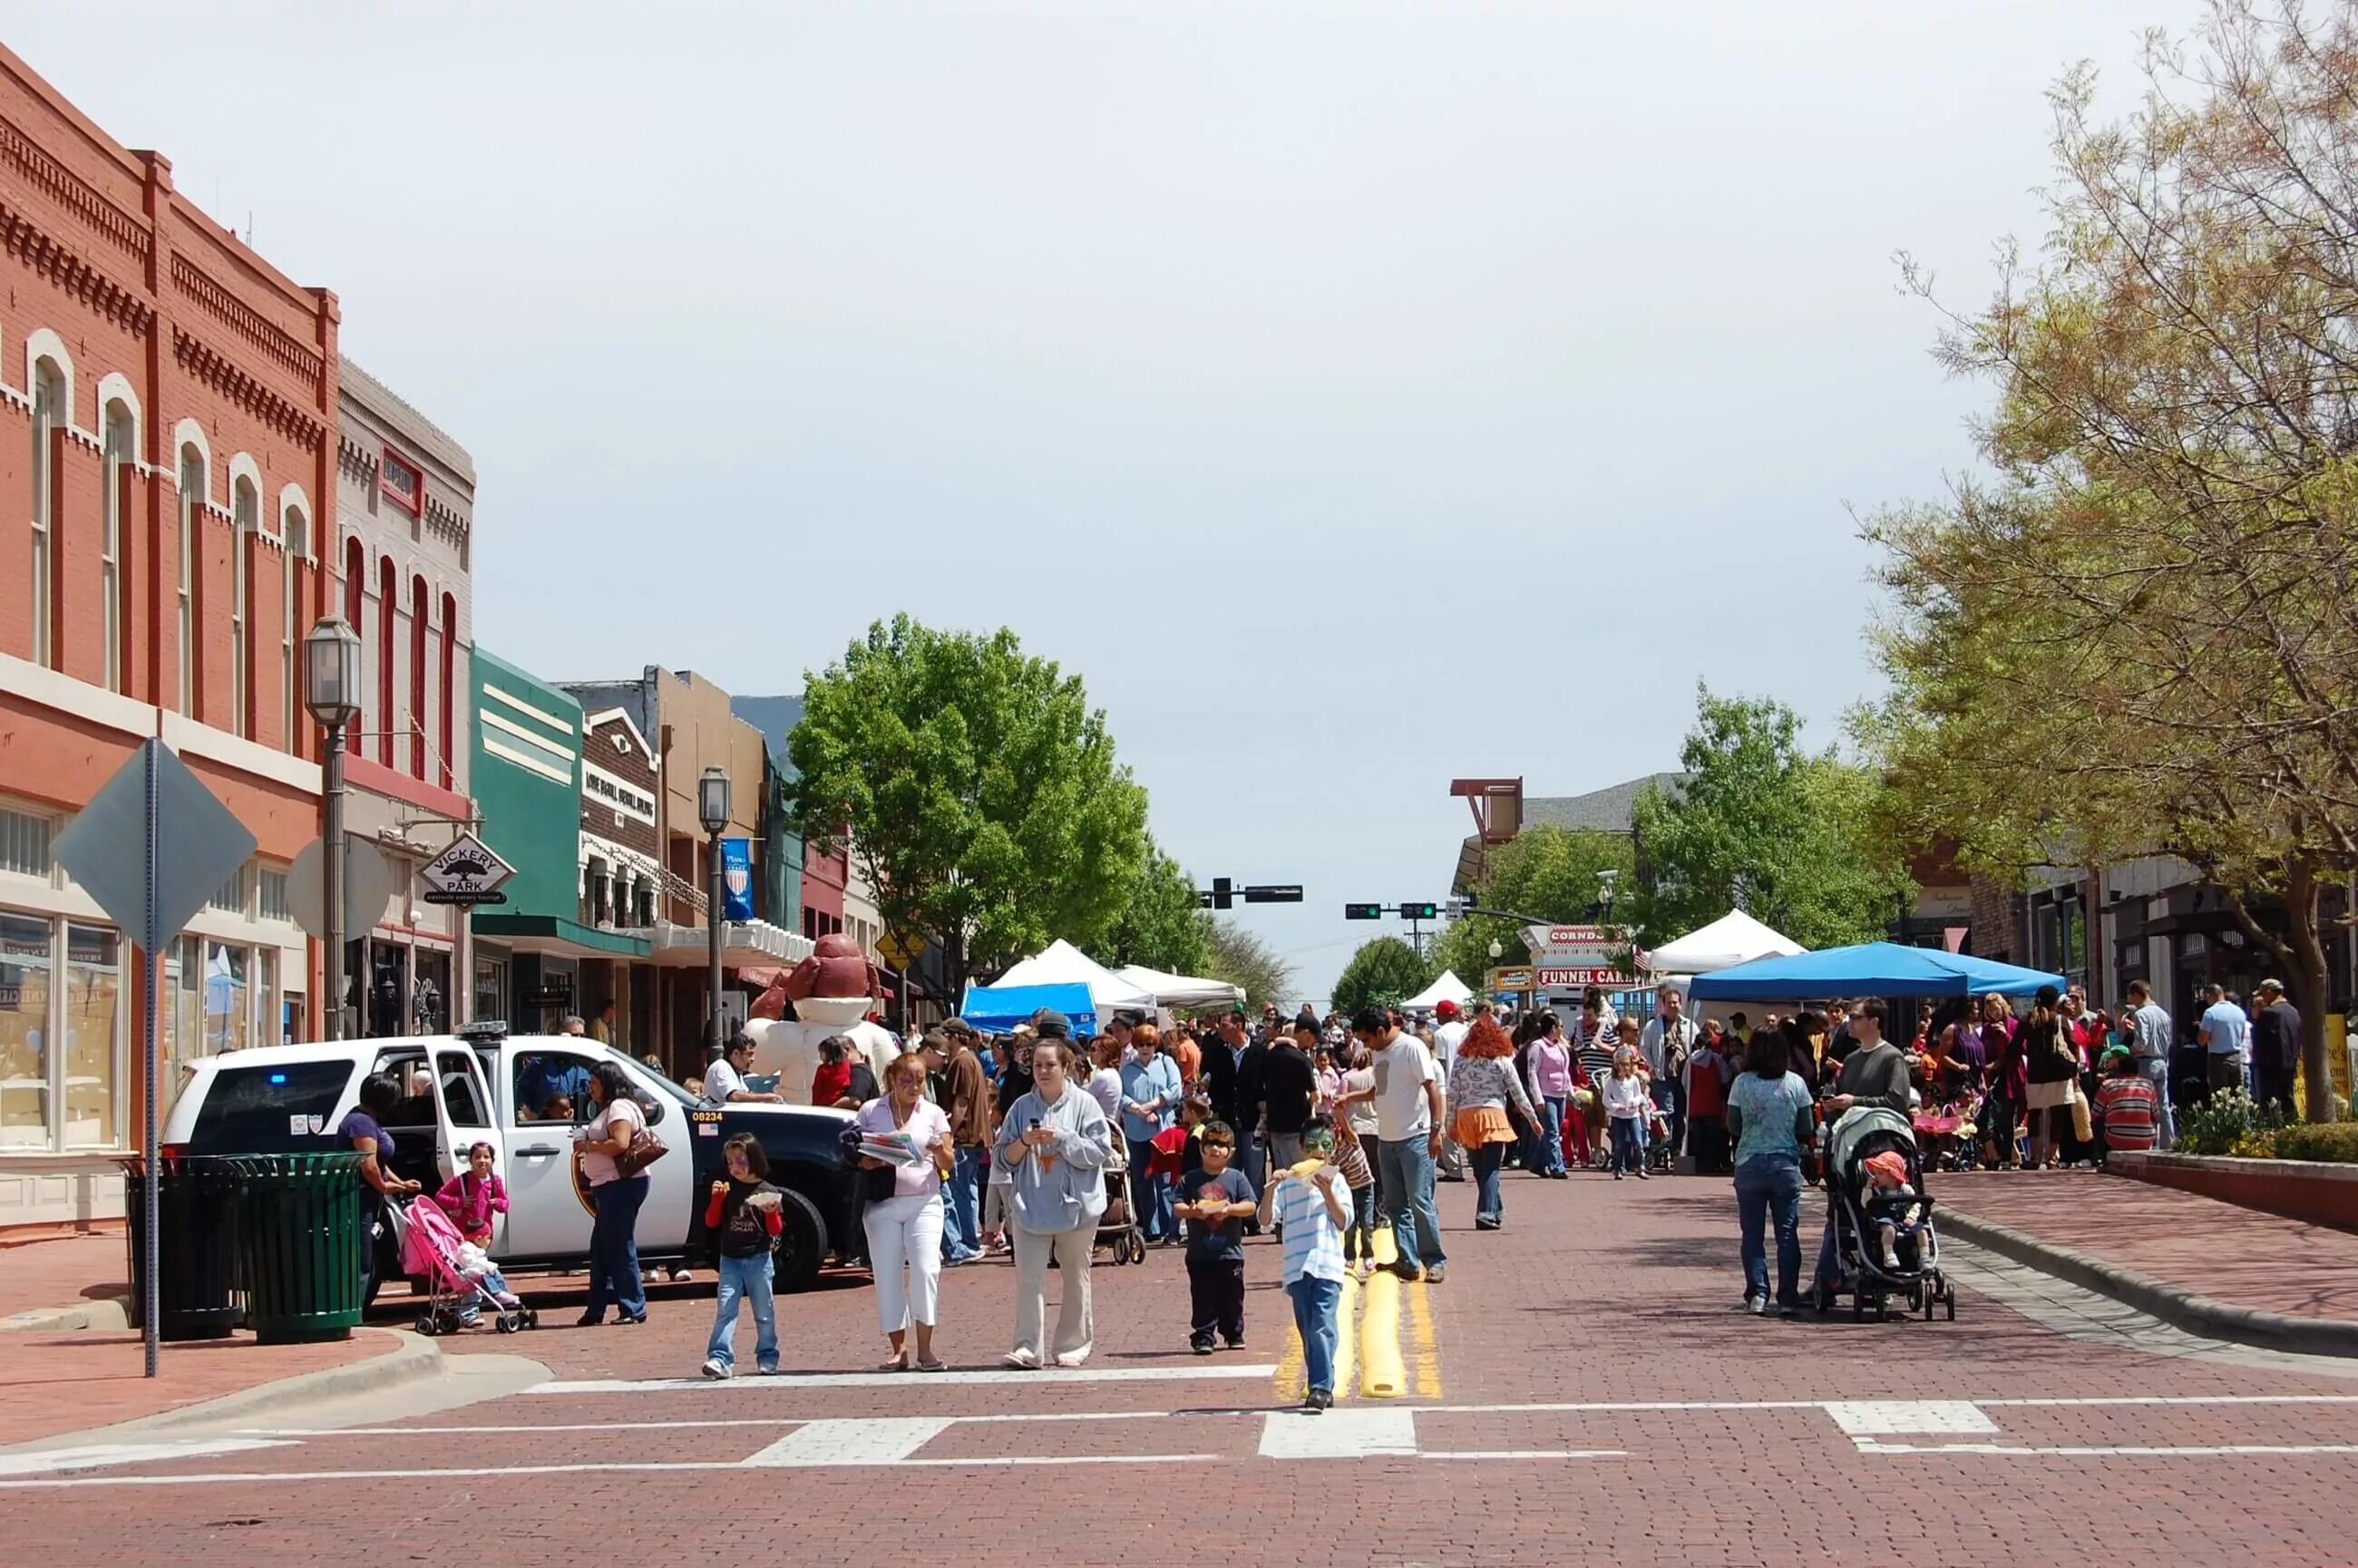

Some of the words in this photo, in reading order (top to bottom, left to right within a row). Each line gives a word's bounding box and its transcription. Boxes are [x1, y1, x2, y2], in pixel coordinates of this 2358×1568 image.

[434, 850, 496, 869] VICKERY
[447, 882, 482, 891] PARK
[1542, 970, 1594, 983] FUNNEL
[692, 1112, 723, 1122] 08234
